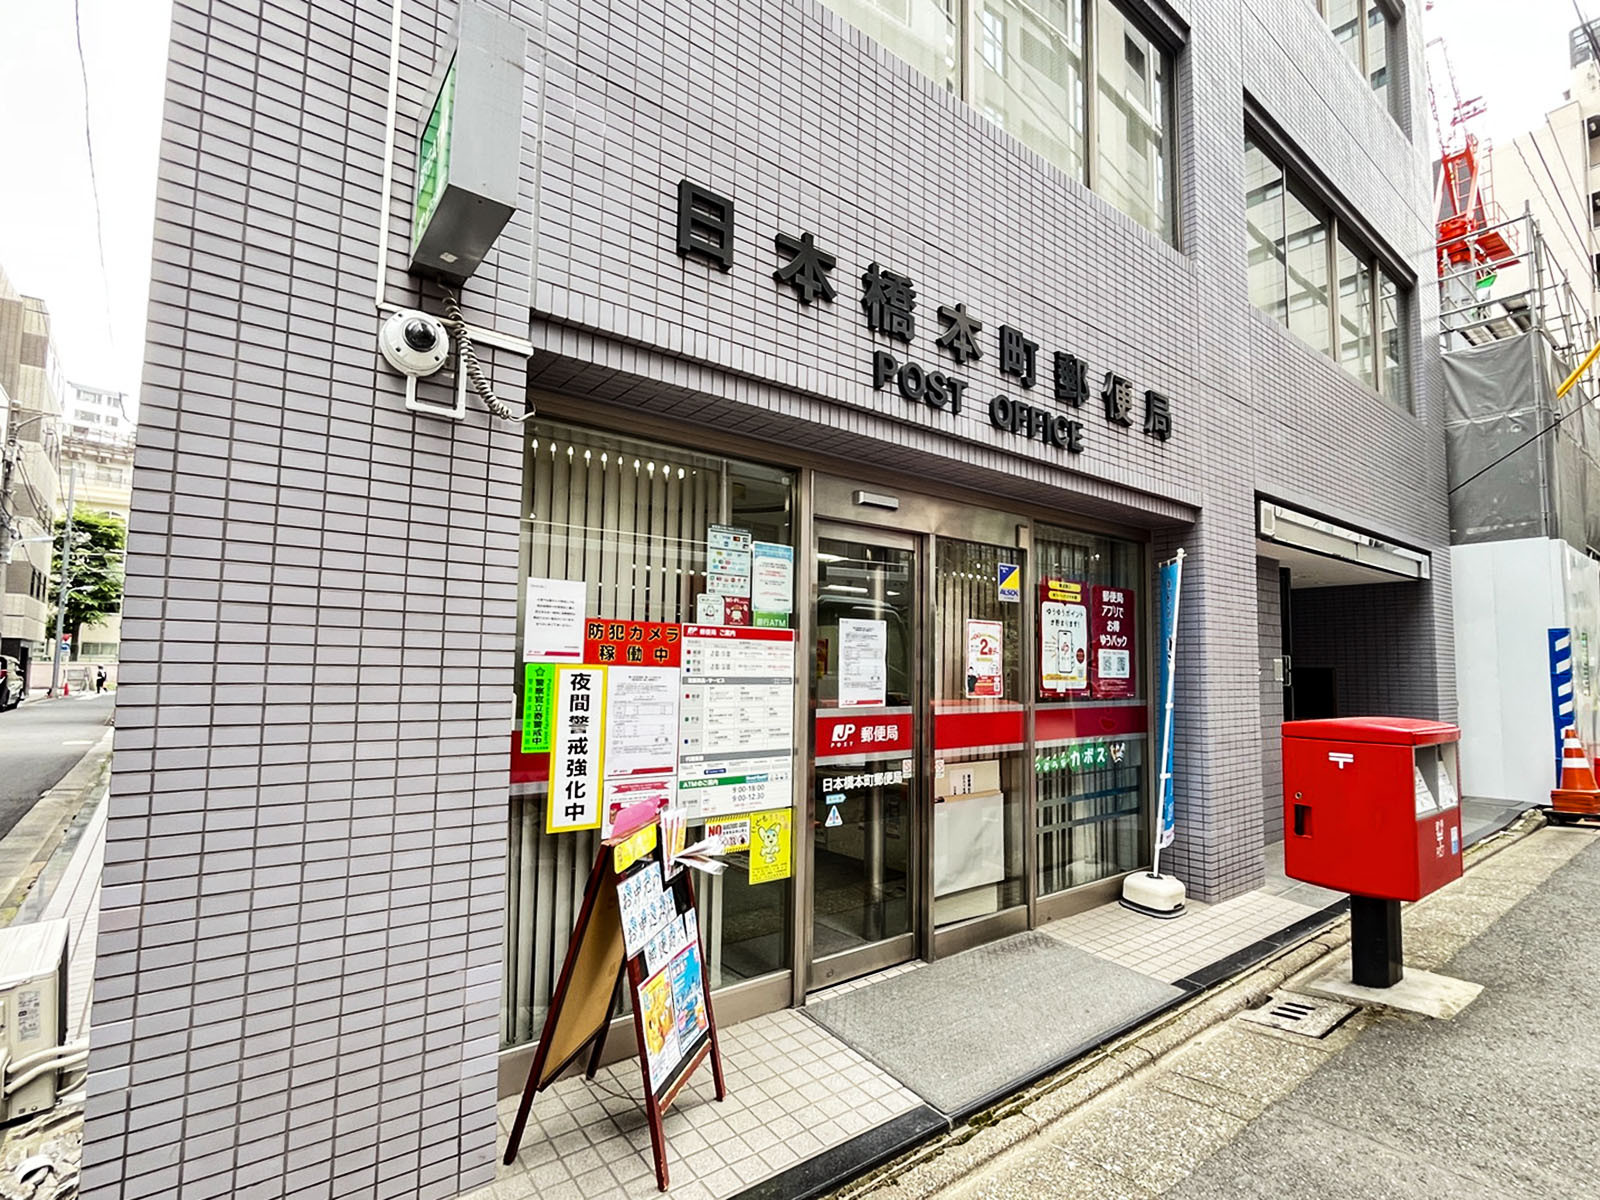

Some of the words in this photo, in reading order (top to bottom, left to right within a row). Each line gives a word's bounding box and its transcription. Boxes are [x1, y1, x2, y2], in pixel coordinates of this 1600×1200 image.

[677, 178, 1173, 441] 日本橋本町郵便局
[873, 350, 969, 415] POST
[989, 394, 1084, 454] OFFICE
[1101, 590, 1124, 604] 郵便局
[1101, 605, 1124, 618] アプリで
[588, 623, 680, 643] 防犯カメラ
[1106, 620, 1120, 632] お得
[1099, 634, 1127, 648] ゆうパック
[599, 645, 669, 663] 稼働中
[832, 724, 855, 742] JP
[861, 725, 898, 743] 郵便局
[564, 673, 592, 822] 夜間警戒強化中
[830, 741, 854, 749] POST
[823, 770, 903, 792] 日本橋本町郵便局
[708, 824, 722, 837] NO
